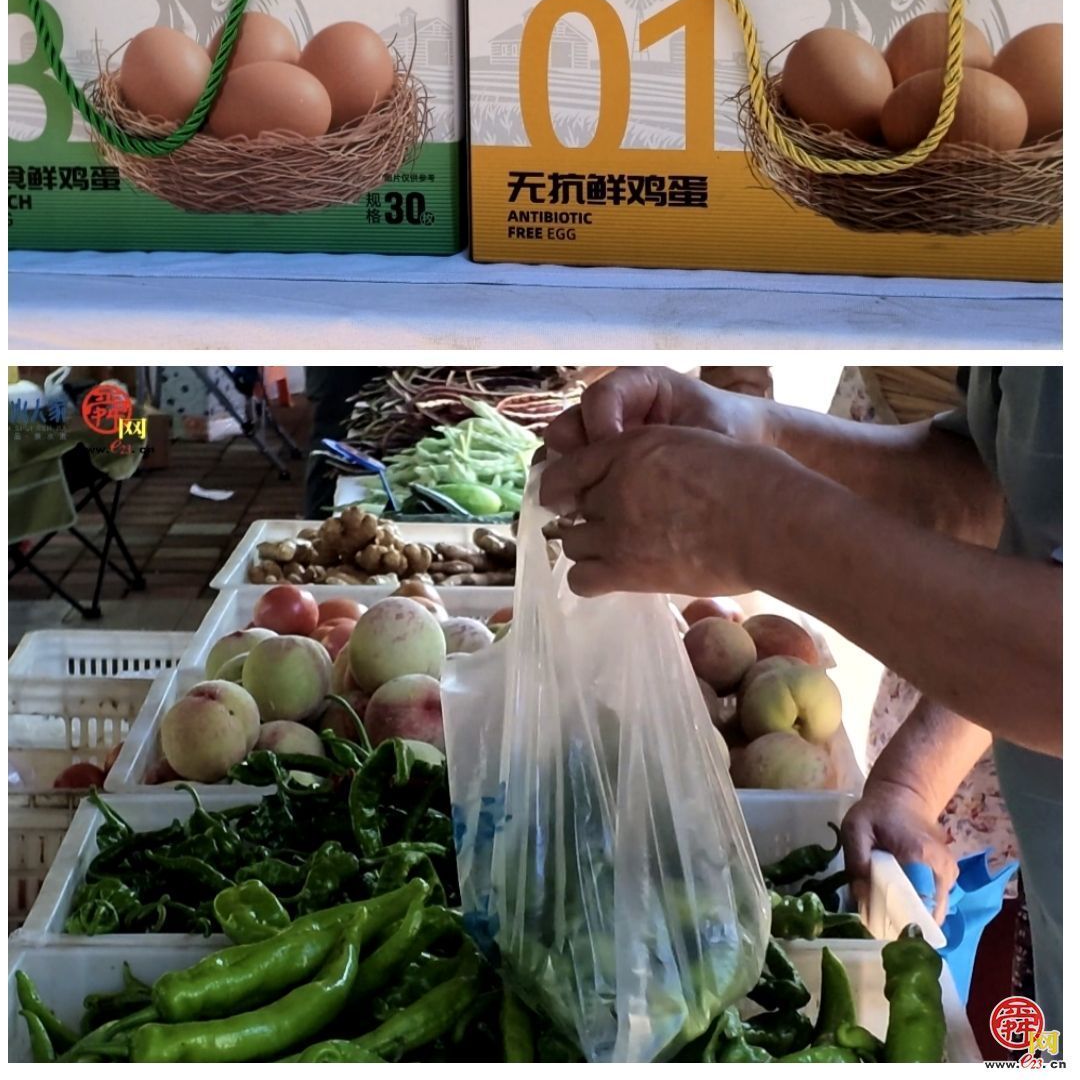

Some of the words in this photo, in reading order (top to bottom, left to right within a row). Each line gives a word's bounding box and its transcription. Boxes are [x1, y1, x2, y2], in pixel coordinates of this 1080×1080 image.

[506, 170, 709, 209] 无抗鲜鸡蛋
[384, 191, 426, 225] 30
[506, 209, 594, 225] ANTIBIOTIC
[507, 225, 544, 240] FREE
[546, 226, 577, 241] EGG
